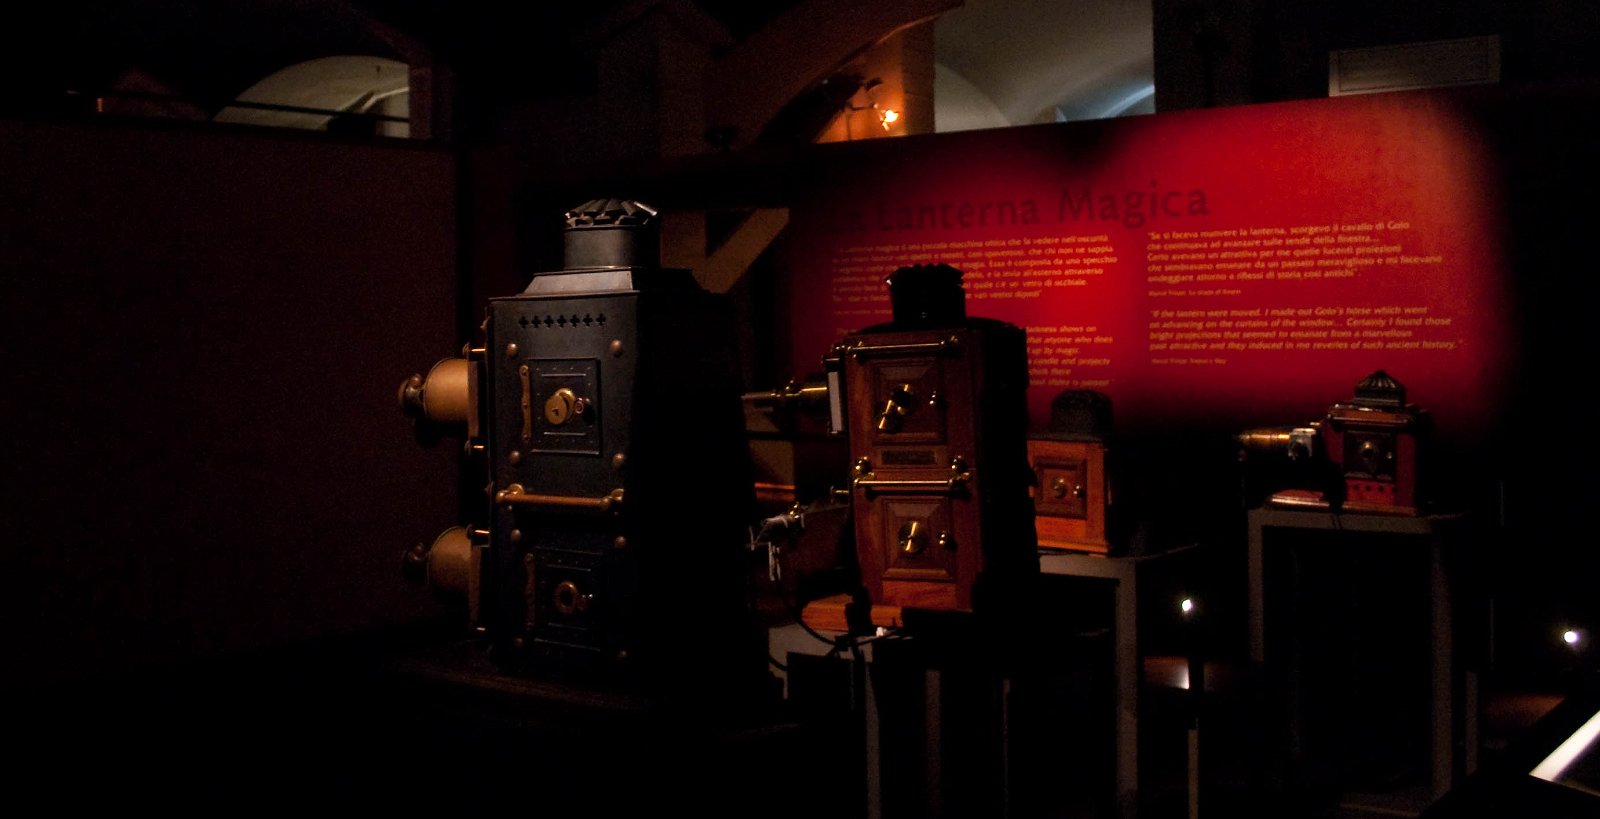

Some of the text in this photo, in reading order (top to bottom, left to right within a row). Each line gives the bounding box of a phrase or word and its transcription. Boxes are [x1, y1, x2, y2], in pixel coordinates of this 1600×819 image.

[878, 199, 1040, 231] Lanterna
[1057, 179, 1210, 230] Magica
[1172, 230, 1198, 239] faceva
[1200, 229, 1237, 238] muovere
[1239, 228, 1247, 236] la
[1290, 225, 1330, 235] scorgevo
[1341, 222, 1373, 231] cavallo
[1375, 221, 1384, 230] di
[1387, 220, 1410, 230] Golo
[1007, 238, 1021, 246] che
[1032, 237, 1059, 245] vedere
[1147, 241, 1161, 250] che
[1164, 241, 1208, 250] continuava
[1210, 239, 1221, 248] ad
[1223, 239, 1261, 247] avanzare
[1263, 237, 1283, 246] sulle
[1285, 236, 1310, 245] tende
[1313, 235, 1335, 244] della
[1028, 248, 1042, 256] che
[1044, 247, 1056, 255] chi
[1087, 246, 1114, 255] sappia
[1147, 252, 1169, 261] Certo
[1171, 252, 1206, 260] avevano
[1259, 250, 1274, 259] per
[1293, 248, 1320, 257] quelle
[1323, 246, 1354, 255] lucenti
[1356, 245, 1401, 255] proiezioni
[1014, 259, 1051, 268] composta
[1053, 257, 1063, 265] da
[1083, 256, 1118, 265] specchio
[1147, 263, 1162, 272] che
[1215, 261, 1251, 270] emanare
[1254, 260, 1265, 268] da
[1281, 259, 1314, 269] passato
[1317, 257, 1375, 267] meraviglioso
[1385, 256, 1398, 264] mi
[1400, 254, 1443, 264] facevano
[1064, 267, 1104, 276] attraverso
[1147, 274, 1194, 284] ondeggiare
[1196, 273, 1226, 281] attorno
[1237, 271, 1263, 280] riflessi
[1266, 270, 1275, 279] di
[1277, 271, 1301, 280] storia
[1161, 309, 1174, 317] the
[1176, 309, 1205, 317] lantern
[1207, 309, 1228, 317] were
[1271, 307, 1295, 315] made
[1297, 307, 1312, 315] out
[1315, 306, 1344, 315] Golo's
[1346, 306, 1371, 315] horse
[1374, 305, 1401, 314] which
[1404, 306, 1428, 314] went
[1060, 325, 1083, 333] shows
[1162, 320, 1203, 330] advancing
[1205, 320, 1217, 328] on
[1219, 319, 1233, 328] the
[1235, 319, 1268, 328] curtains
[1270, 318, 1281, 327] of
[1282, 318, 1296, 327] the
[1347, 317, 1386, 327] Certainly
[1395, 317, 1422, 325] found
[1425, 316, 1451, 325] those
[1043, 336, 1073, 345] anyone
[1093, 335, 1113, 344] does
[1150, 331, 1174, 341] bright
[1175, 331, 1221, 340] projections
[1223, 331, 1241, 339] that
[1242, 330, 1276, 339] seemed
[1290, 330, 1327, 338] emanate
[1330, 329, 1352, 337] from
[1362, 329, 1412, 338] marvellous
[1150, 342, 1168, 351] past
[1169, 342, 1207, 350] attractive
[1209, 341, 1226, 350] and
[1228, 341, 1247, 352] they
[1248, 341, 1284, 350] induced
[1285, 340, 1294, 349] in
[1296, 341, 1310, 349] me
[1313, 341, 1349, 349] reveries
[1351, 340, 1361, 349] of
[1363, 340, 1384, 349] such
[1386, 340, 1420, 349] ancient
[1061, 357, 1077, 365] and
